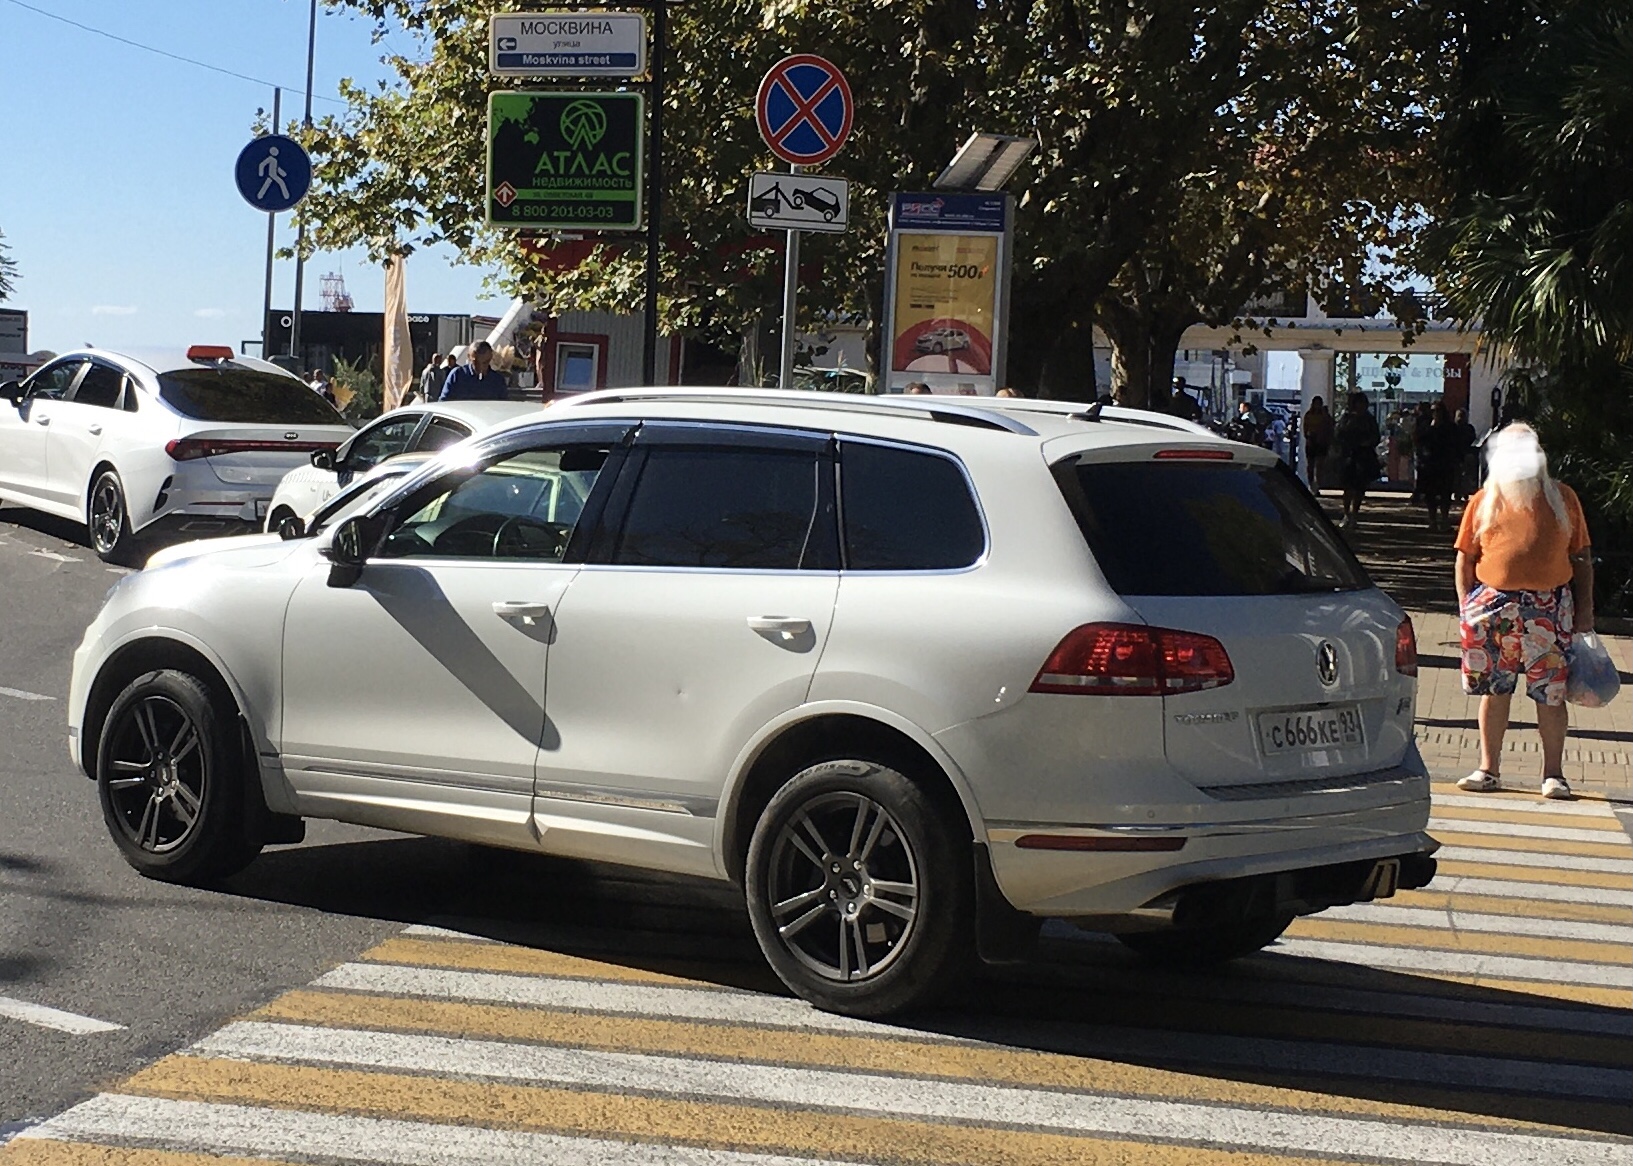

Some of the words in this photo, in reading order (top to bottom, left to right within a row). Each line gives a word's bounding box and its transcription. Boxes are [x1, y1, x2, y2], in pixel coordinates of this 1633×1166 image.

[520, 21, 613, 35] МОСКВИНА
[522, 54, 575, 65] Moskvina
[578, 54, 611, 65] street
[534, 151, 631, 176] АТЛАС
[511, 205, 520, 216] 8
[523, 206, 548, 217] 800
[551, 206, 614, 218] 201-03-03
[1340, 711, 1354, 733] 93
